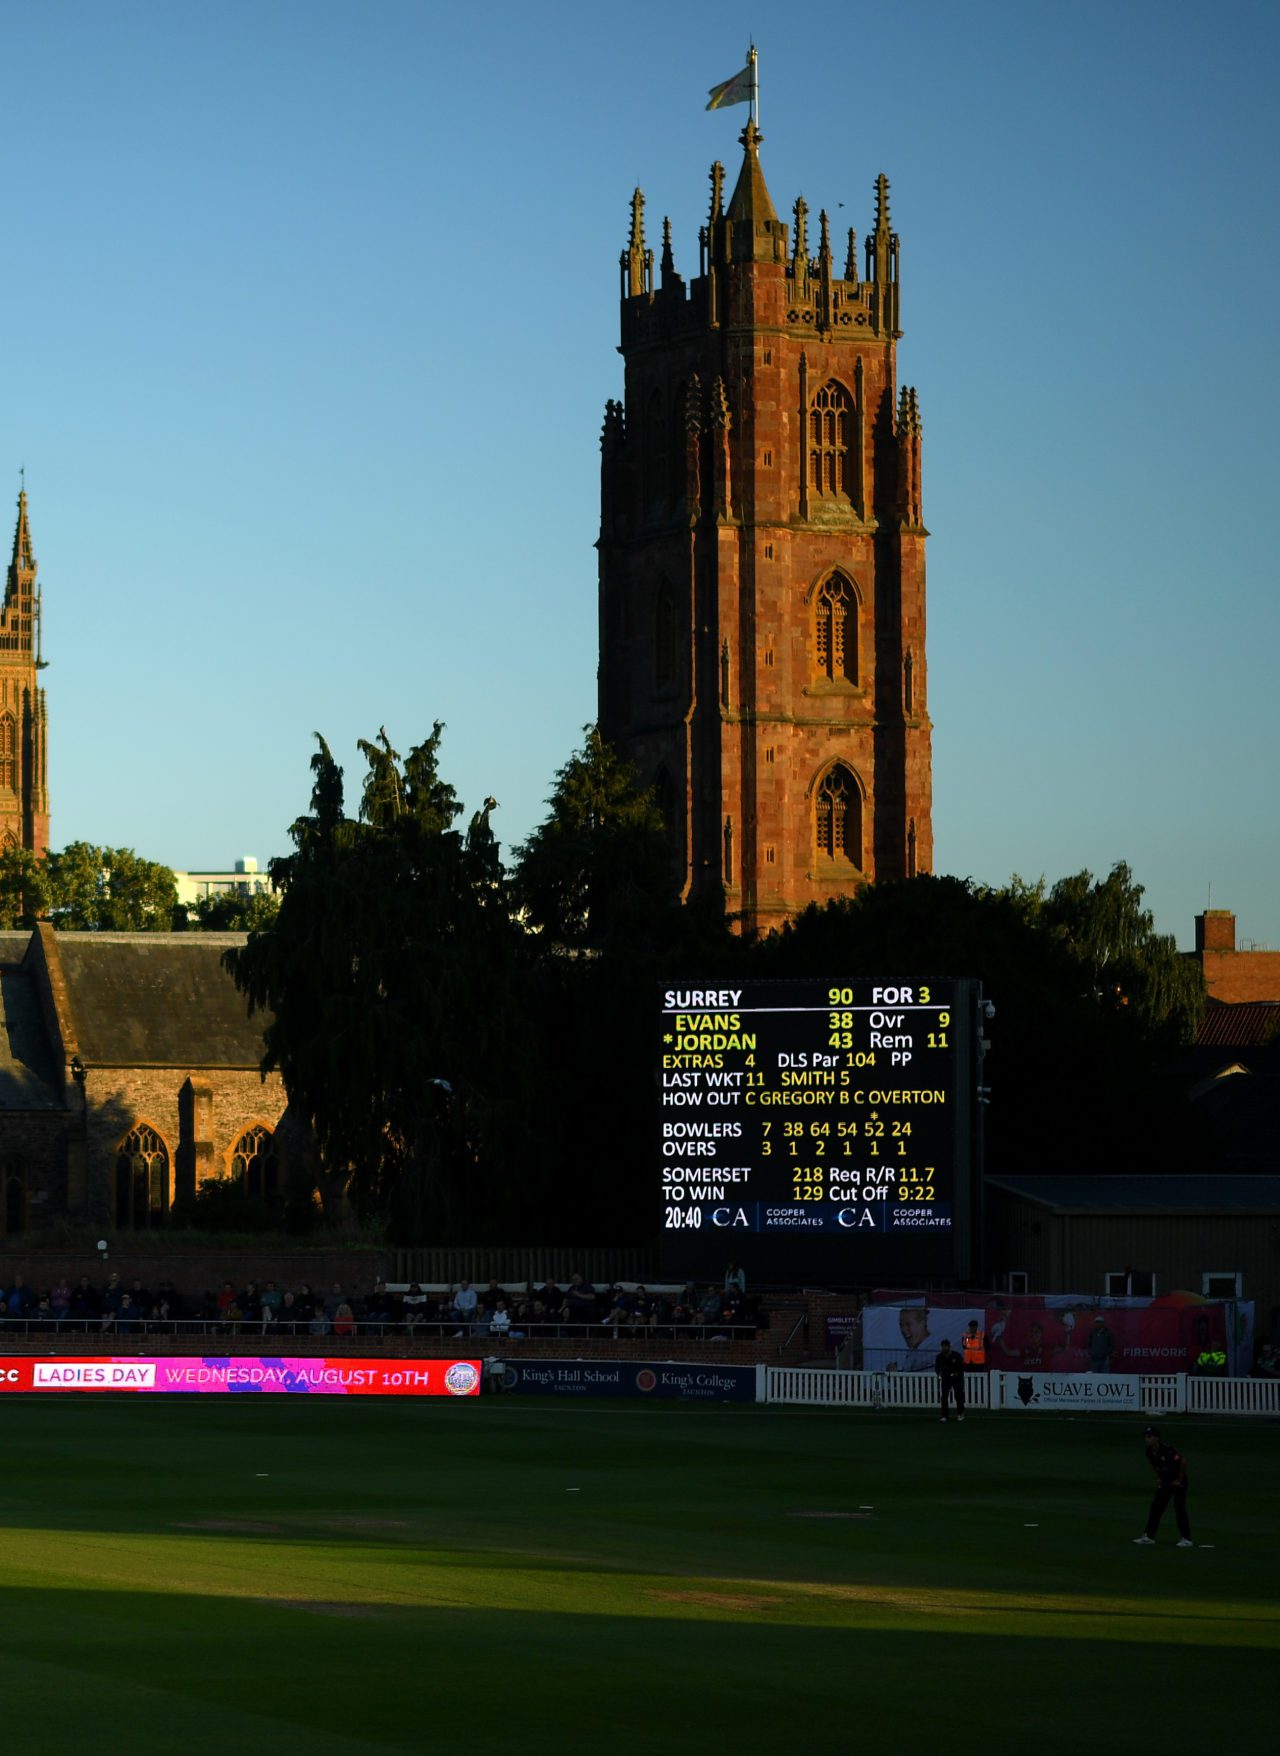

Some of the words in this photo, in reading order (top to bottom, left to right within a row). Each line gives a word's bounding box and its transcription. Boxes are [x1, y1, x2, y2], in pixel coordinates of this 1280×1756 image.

[664, 990, 742, 1008] SURREY
[828, 988, 853, 1005] 90
[872, 987, 913, 1004] FOR
[918, 987, 930, 1003] 3
[675, 1014, 741, 1031] EVANS
[828, 1013, 853, 1029] 38
[869, 1012, 905, 1028] Ovr
[939, 1013, 950, 1028] 9
[828, 1033, 853, 1048] 43
[870, 1032, 913, 1048] Rem
[927, 1033, 948, 1048] 11
[663, 1055, 724, 1069] EXTRAS
[745, 1054, 756, 1068] 4
[778, 1053, 808, 1068] DLS
[812, 1052, 839, 1067] Par
[846, 1052, 876, 1066] 104
[891, 1052, 912, 1066] PP
[663, 1073, 701, 1087] LAST
[706, 1072, 743, 1086] WKT
[746, 1072, 765, 1086] 11
[781, 1072, 835, 1085] SMITH
[840, 1072, 850, 1085] 5
[663, 1092, 702, 1106] HOW
[708, 1092, 741, 1105] OUT
[745, 1092, 756, 1105] C
[760, 1091, 834, 1105] GREGORY
[839, 1091, 849, 1104] B
[854, 1091, 864, 1104] C
[868, 1090, 945, 1104] OVERTON
[663, 1123, 742, 1137] BOWLERS
[761, 1122, 772, 1136] 7
[783, 1122, 804, 1136] 38
[810, 1122, 830, 1136] 64
[837, 1122, 857, 1136] 54
[864, 1122, 885, 1136] 52
[891, 1122, 912, 1136] 24
[663, 1142, 716, 1157] OVERS
[761, 1142, 772, 1155] 3
[789, 1142, 798, 1155] 1
[815, 1141, 825, 1155] 2
[843, 1141, 852, 1155] 1
[870, 1141, 879, 1155] 1
[897, 1141, 907, 1155] 1
[663, 1168, 751, 1182] SOMERSET
[792, 1168, 823, 1182] 218
[829, 1168, 860, 1185] Req
[866, 1167, 895, 1182] R/R
[899, 1167, 934, 1181] 11.7
[663, 1187, 685, 1200] TO
[689, 1186, 724, 1200] WIN
[793, 1186, 823, 1200] 129
[829, 1185, 857, 1200] Cut
[862, 1185, 888, 1200] Off
[898, 1186, 935, 1200] 9:22
[665, 1206, 701, 1229] 20:40
[766, 1209, 805, 1217] COOPER
[766, 1218, 823, 1226] ASSOCIATES
[893, 1218, 952, 1227] ASSOCIATES
[39, 1368, 105, 1382] LADIES
[112, 1368, 150, 1382] DAY
[297, 1370, 377, 1385] AUGUST
[382, 1371, 429, 1386] 10TH
[522, 1369, 554, 1384] King's
[558, 1370, 581, 1382] Hall
[584, 1370, 619, 1383] School
[661, 1373, 694, 1389] King's
[696, 1374, 737, 1391] College
[1043, 1382, 1093, 1396] SUAVE
[1097, 1383, 1135, 1397] OWL
